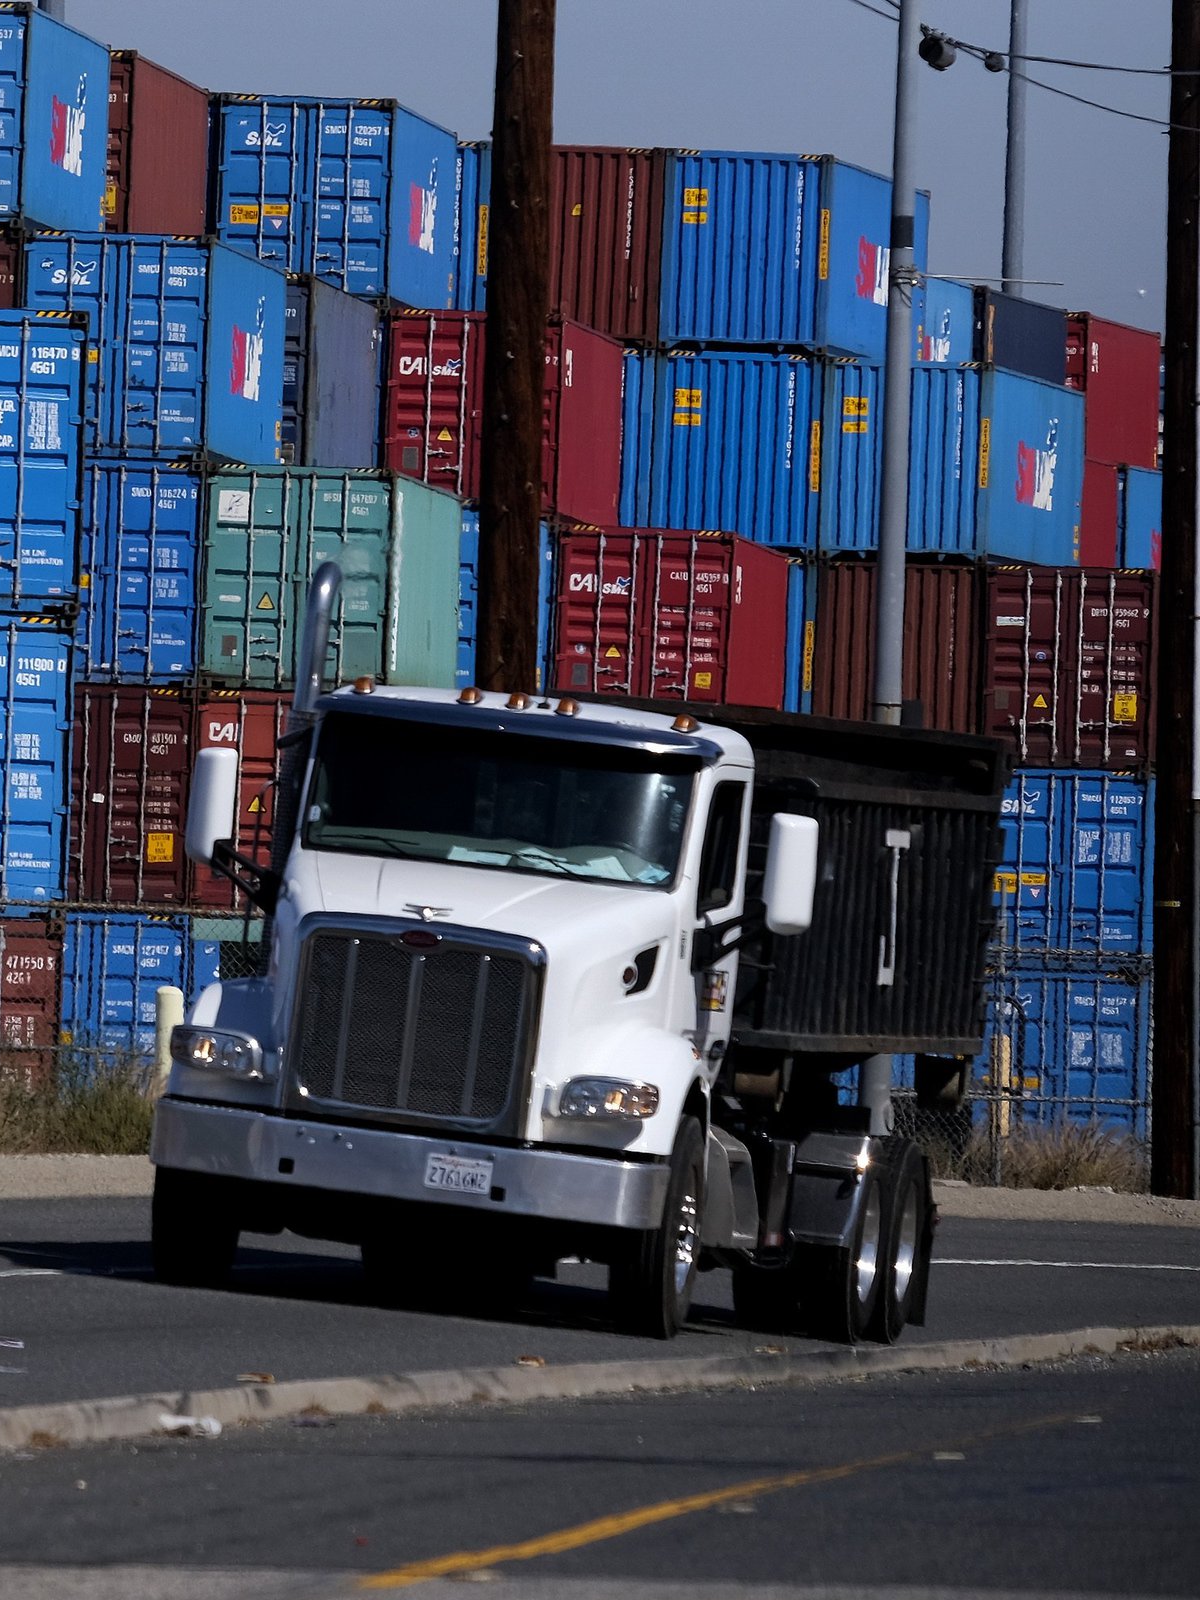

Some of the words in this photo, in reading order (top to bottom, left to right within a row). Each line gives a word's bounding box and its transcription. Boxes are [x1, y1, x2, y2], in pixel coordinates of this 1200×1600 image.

[325, 125, 347, 135] SMCU
[138, 265, 160, 275] SMCU
[169, 266, 198, 277] 109633
[31, 347, 68, 360] 116470
[72, 348, 81, 361] 9
[131, 487, 153, 498] SMCU
[159, 488, 187, 500] 106224
[670, 572, 689, 582] CAIU
[18, 658, 55, 672] 111900
[6, 955, 44, 970] 471550
